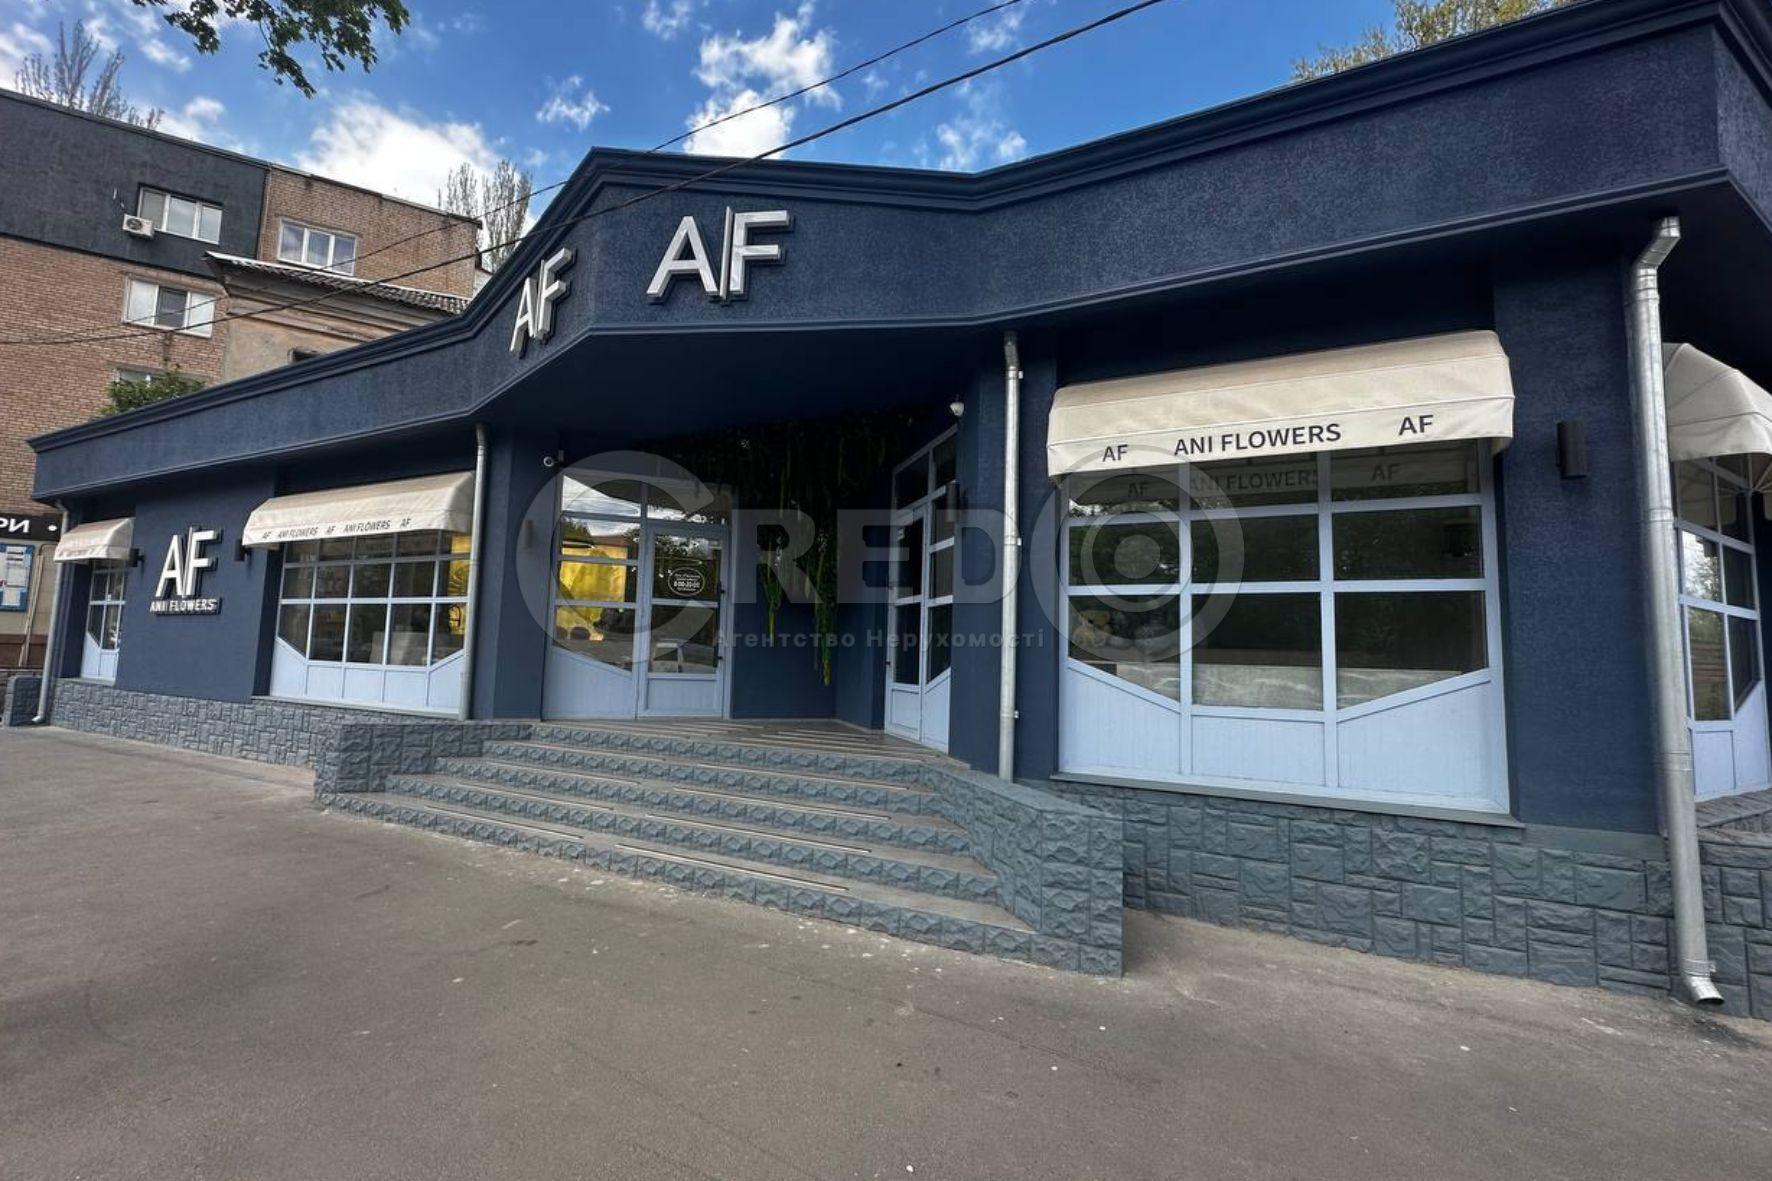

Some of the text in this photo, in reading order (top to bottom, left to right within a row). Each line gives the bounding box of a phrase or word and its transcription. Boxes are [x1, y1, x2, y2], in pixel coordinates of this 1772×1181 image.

[1102, 414, 1435, 462] AF ANI FLOWERS AF
[149, 598, 217, 612] ANI FLOWERS
